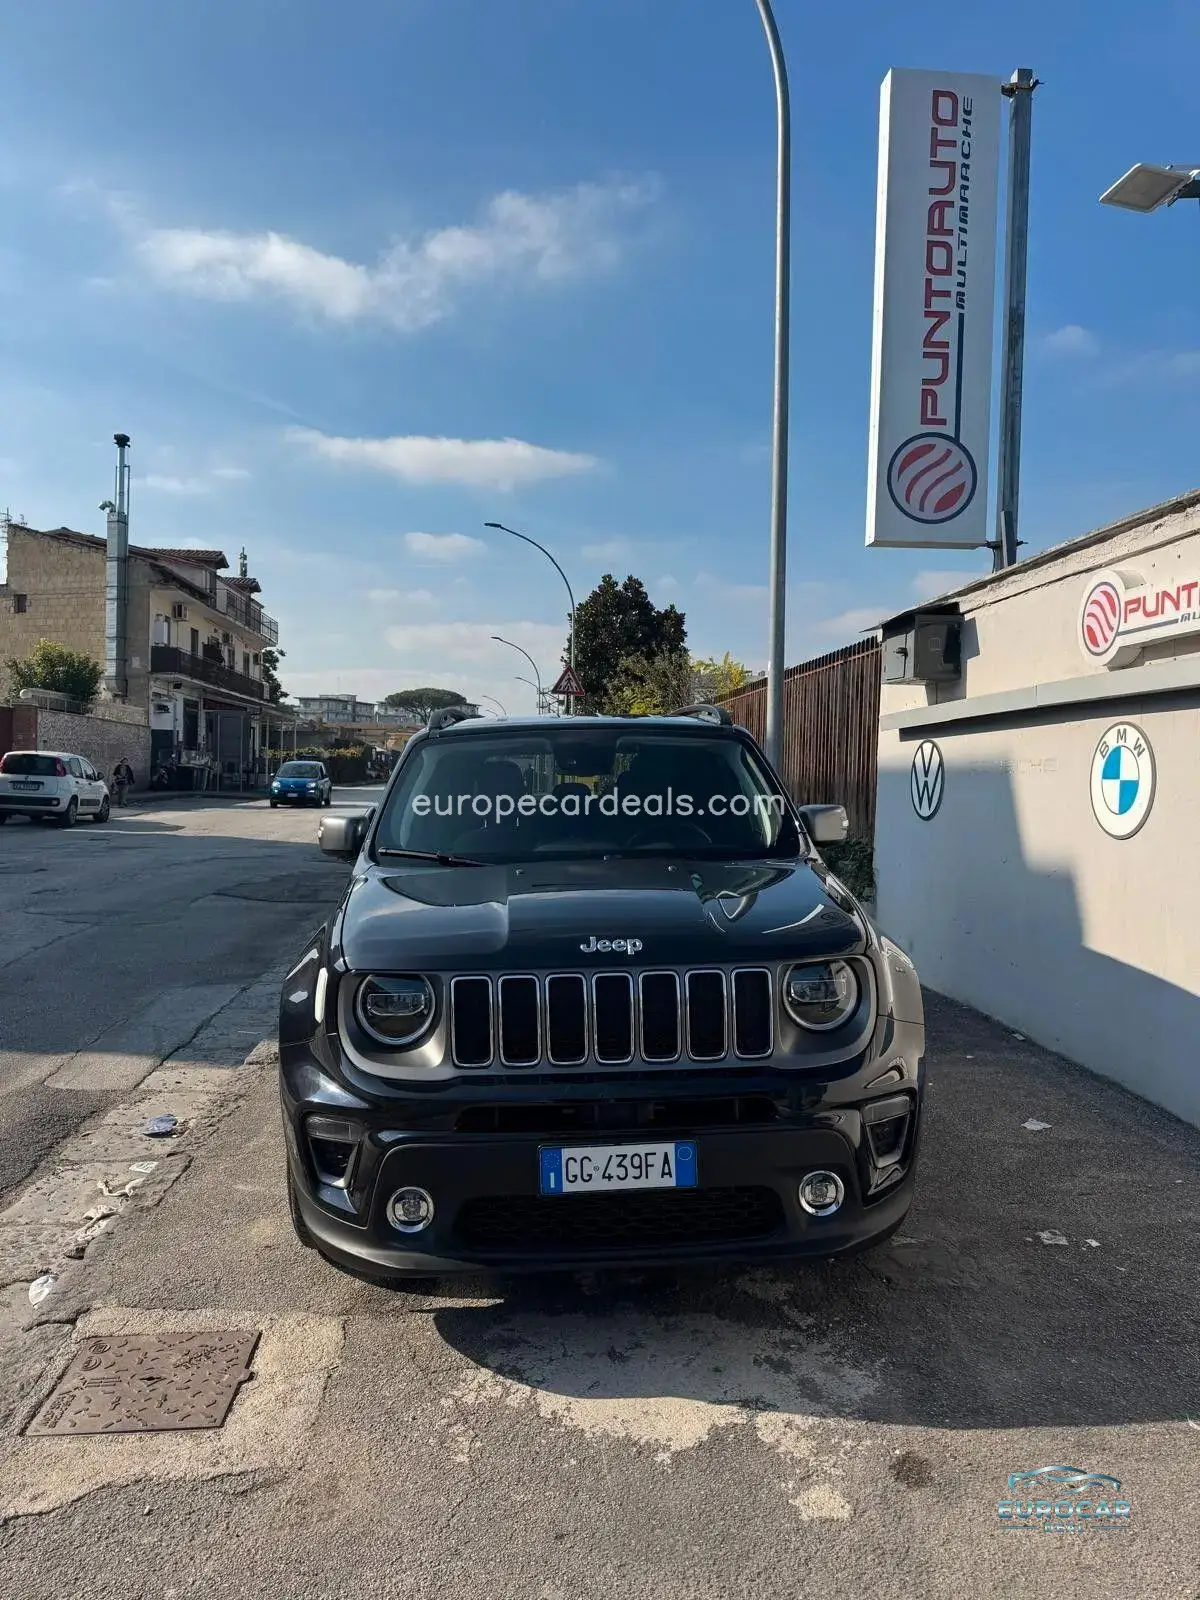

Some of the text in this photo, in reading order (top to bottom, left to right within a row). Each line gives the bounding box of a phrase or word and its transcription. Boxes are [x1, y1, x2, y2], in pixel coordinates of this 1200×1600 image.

[956, 96, 974, 311] MULTIMARCHE
[920, 89, 959, 426] PUNTOAUTO
[1124, 581, 1200, 623] PUNT
[1099, 728, 1146, 759] BMW
[579, 935, 643, 955] Jeep
